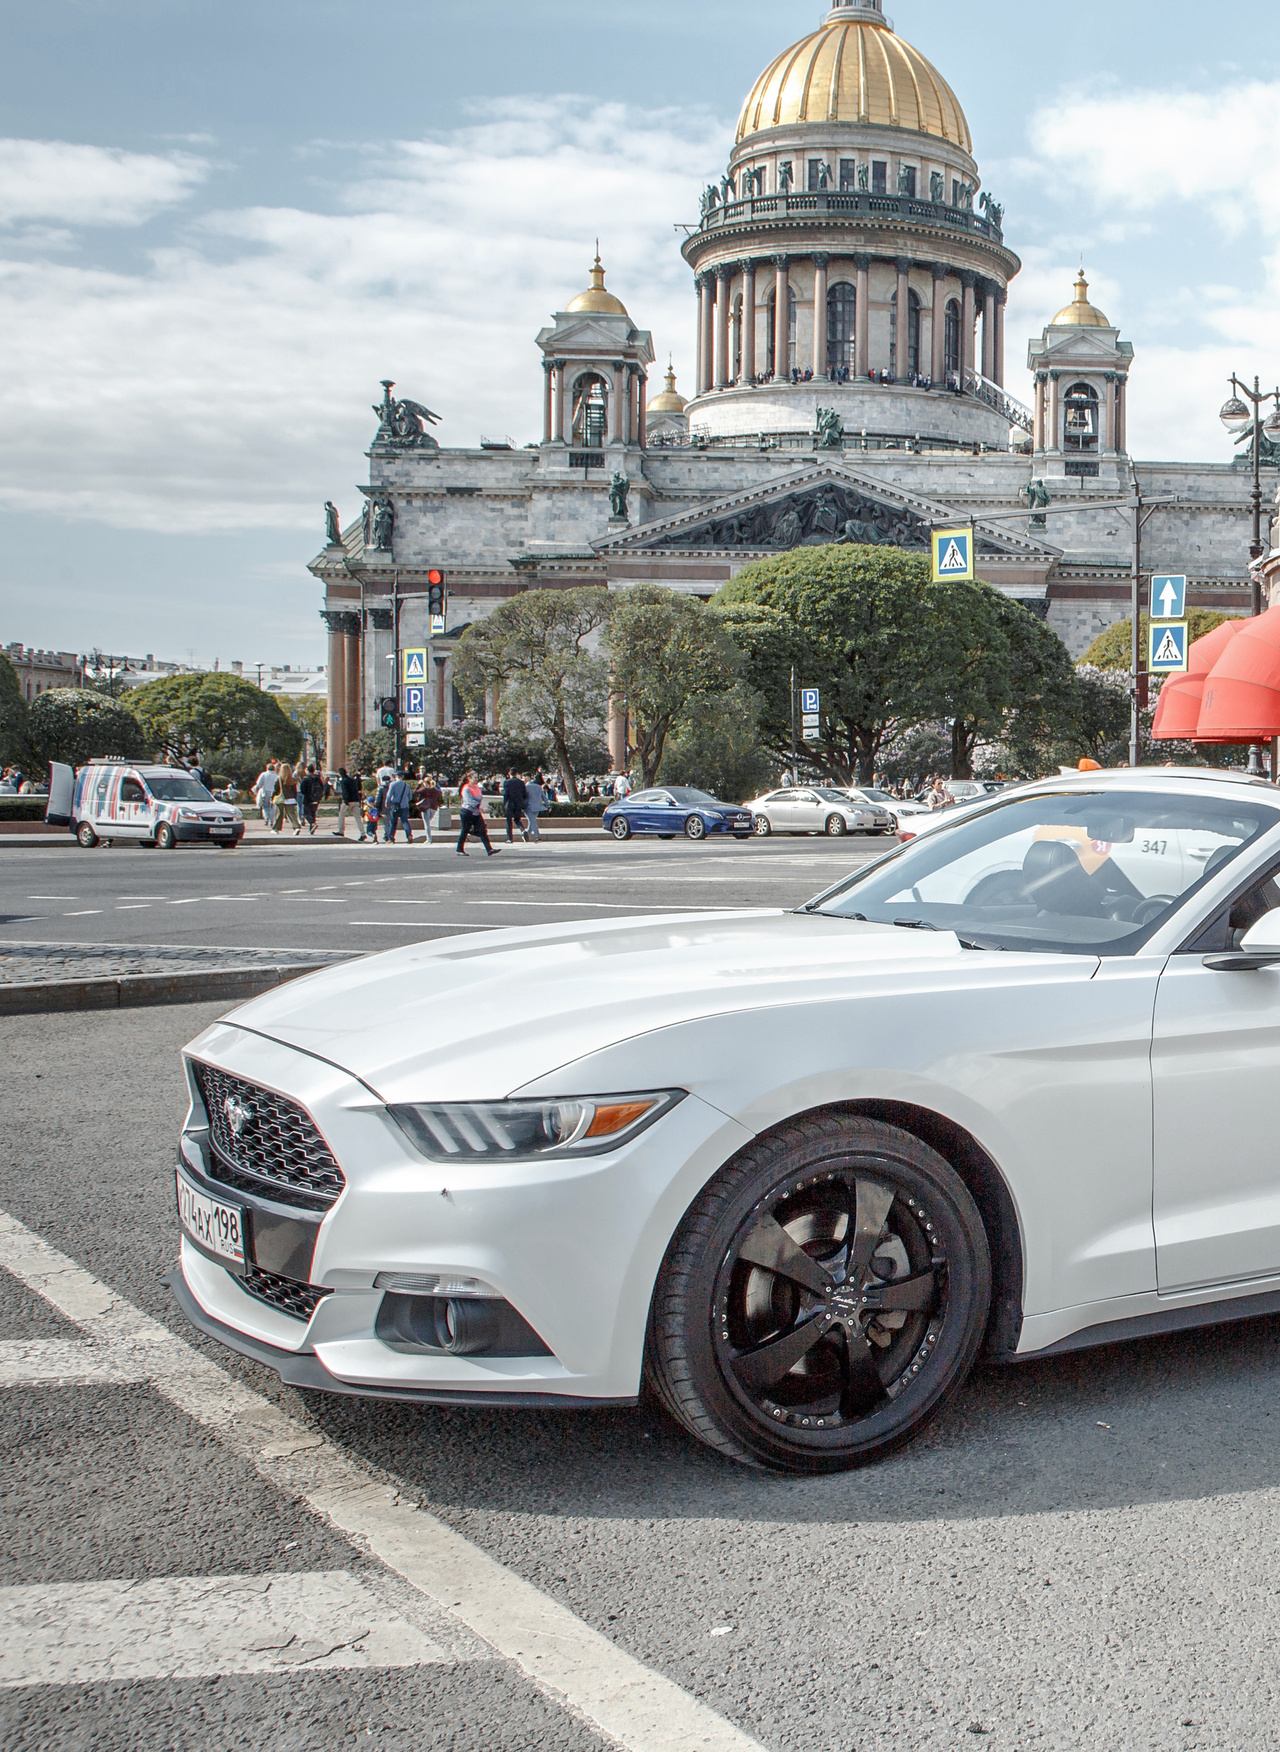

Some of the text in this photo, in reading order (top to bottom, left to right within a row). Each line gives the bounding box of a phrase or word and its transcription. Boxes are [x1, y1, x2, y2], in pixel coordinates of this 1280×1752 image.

[410, 690, 421, 711] P
[806, 691, 816, 710] P
[1141, 840, 1167, 855] 347
[214, 1206, 239, 1243] 198
[220, 1239, 234, 1254] RUS
